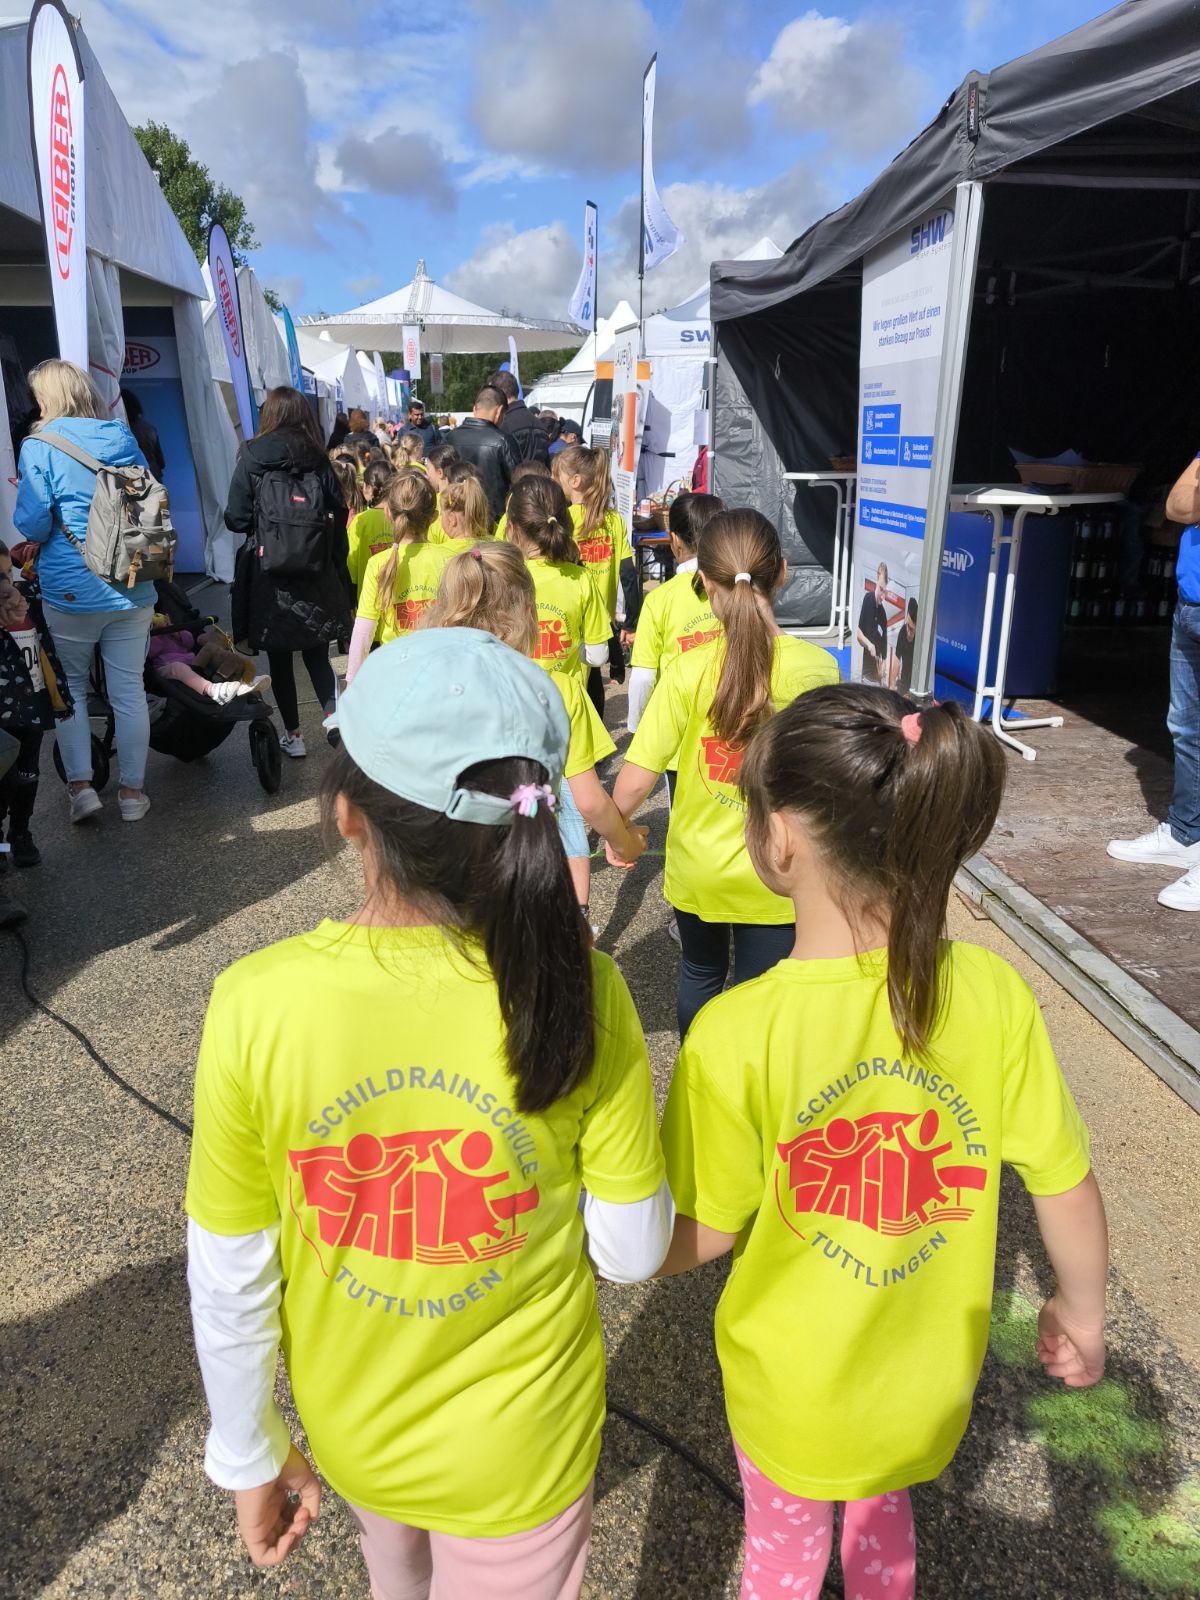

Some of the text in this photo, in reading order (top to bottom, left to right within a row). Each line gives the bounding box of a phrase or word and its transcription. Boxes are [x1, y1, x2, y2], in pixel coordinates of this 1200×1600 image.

[54, 91, 72, 257] LEIBER
[911, 212, 947, 255] SHW
[942, 550, 968, 571] SHW
[308, 1066, 539, 1180] SCHILDRAINSCHULE
[797, 1057, 987, 1157] SCHILDRAINSCHULE
[811, 1230, 947, 1287] TUTTLINGEN
[334, 1265, 503, 1319] TUTTLINGEN
